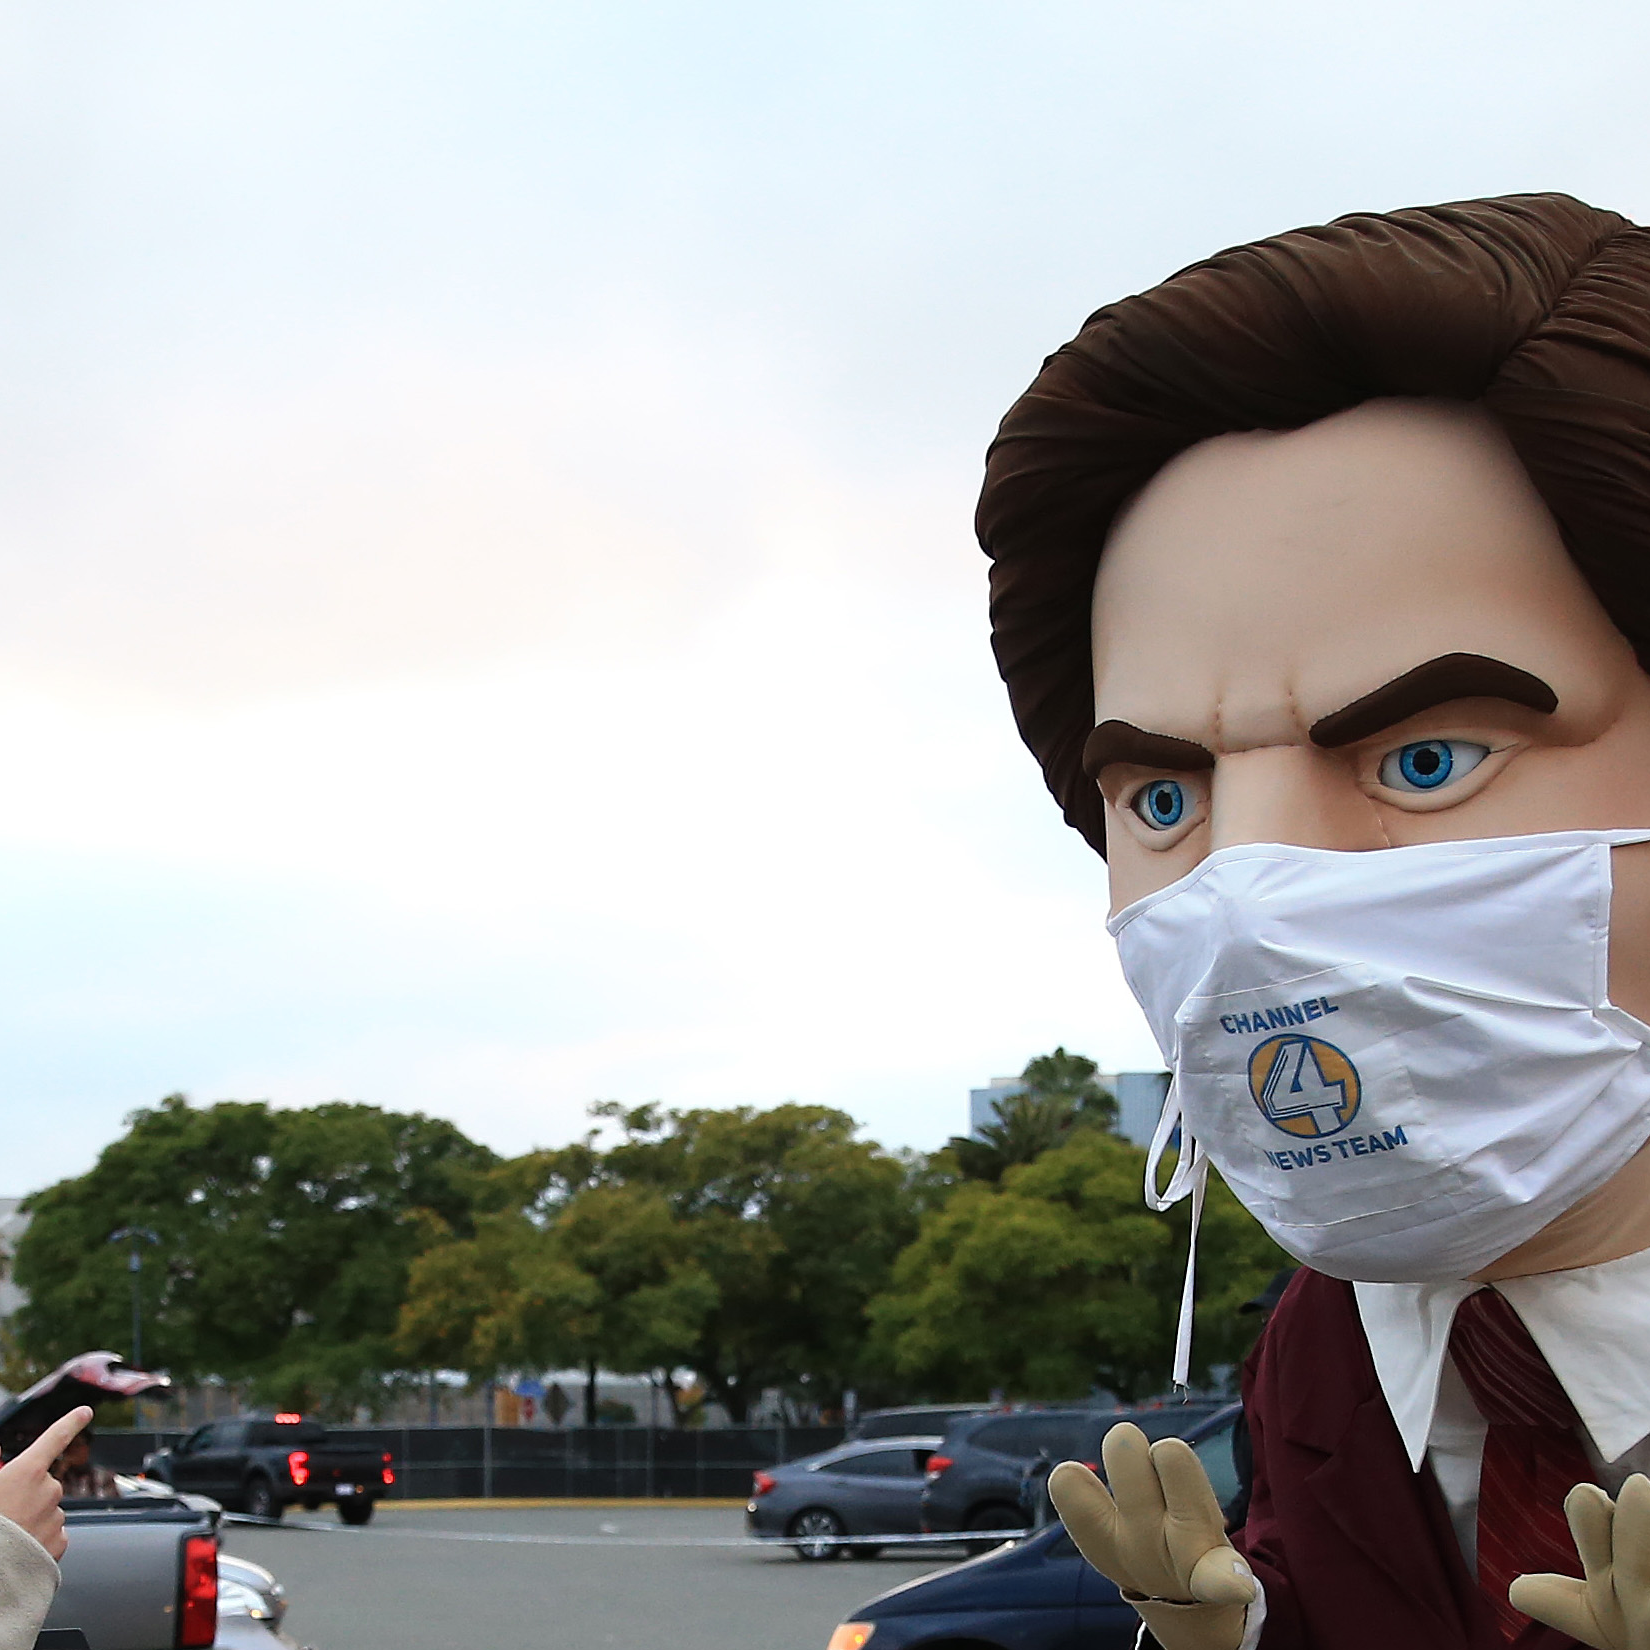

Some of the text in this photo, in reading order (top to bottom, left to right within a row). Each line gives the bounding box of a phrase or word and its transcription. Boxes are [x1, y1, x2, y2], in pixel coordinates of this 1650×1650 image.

[1219, 996, 1339, 1035] CHANNEL
[1262, 1040, 1349, 1136] 4
[1264, 1124, 1409, 1171] NEWS TEAM
